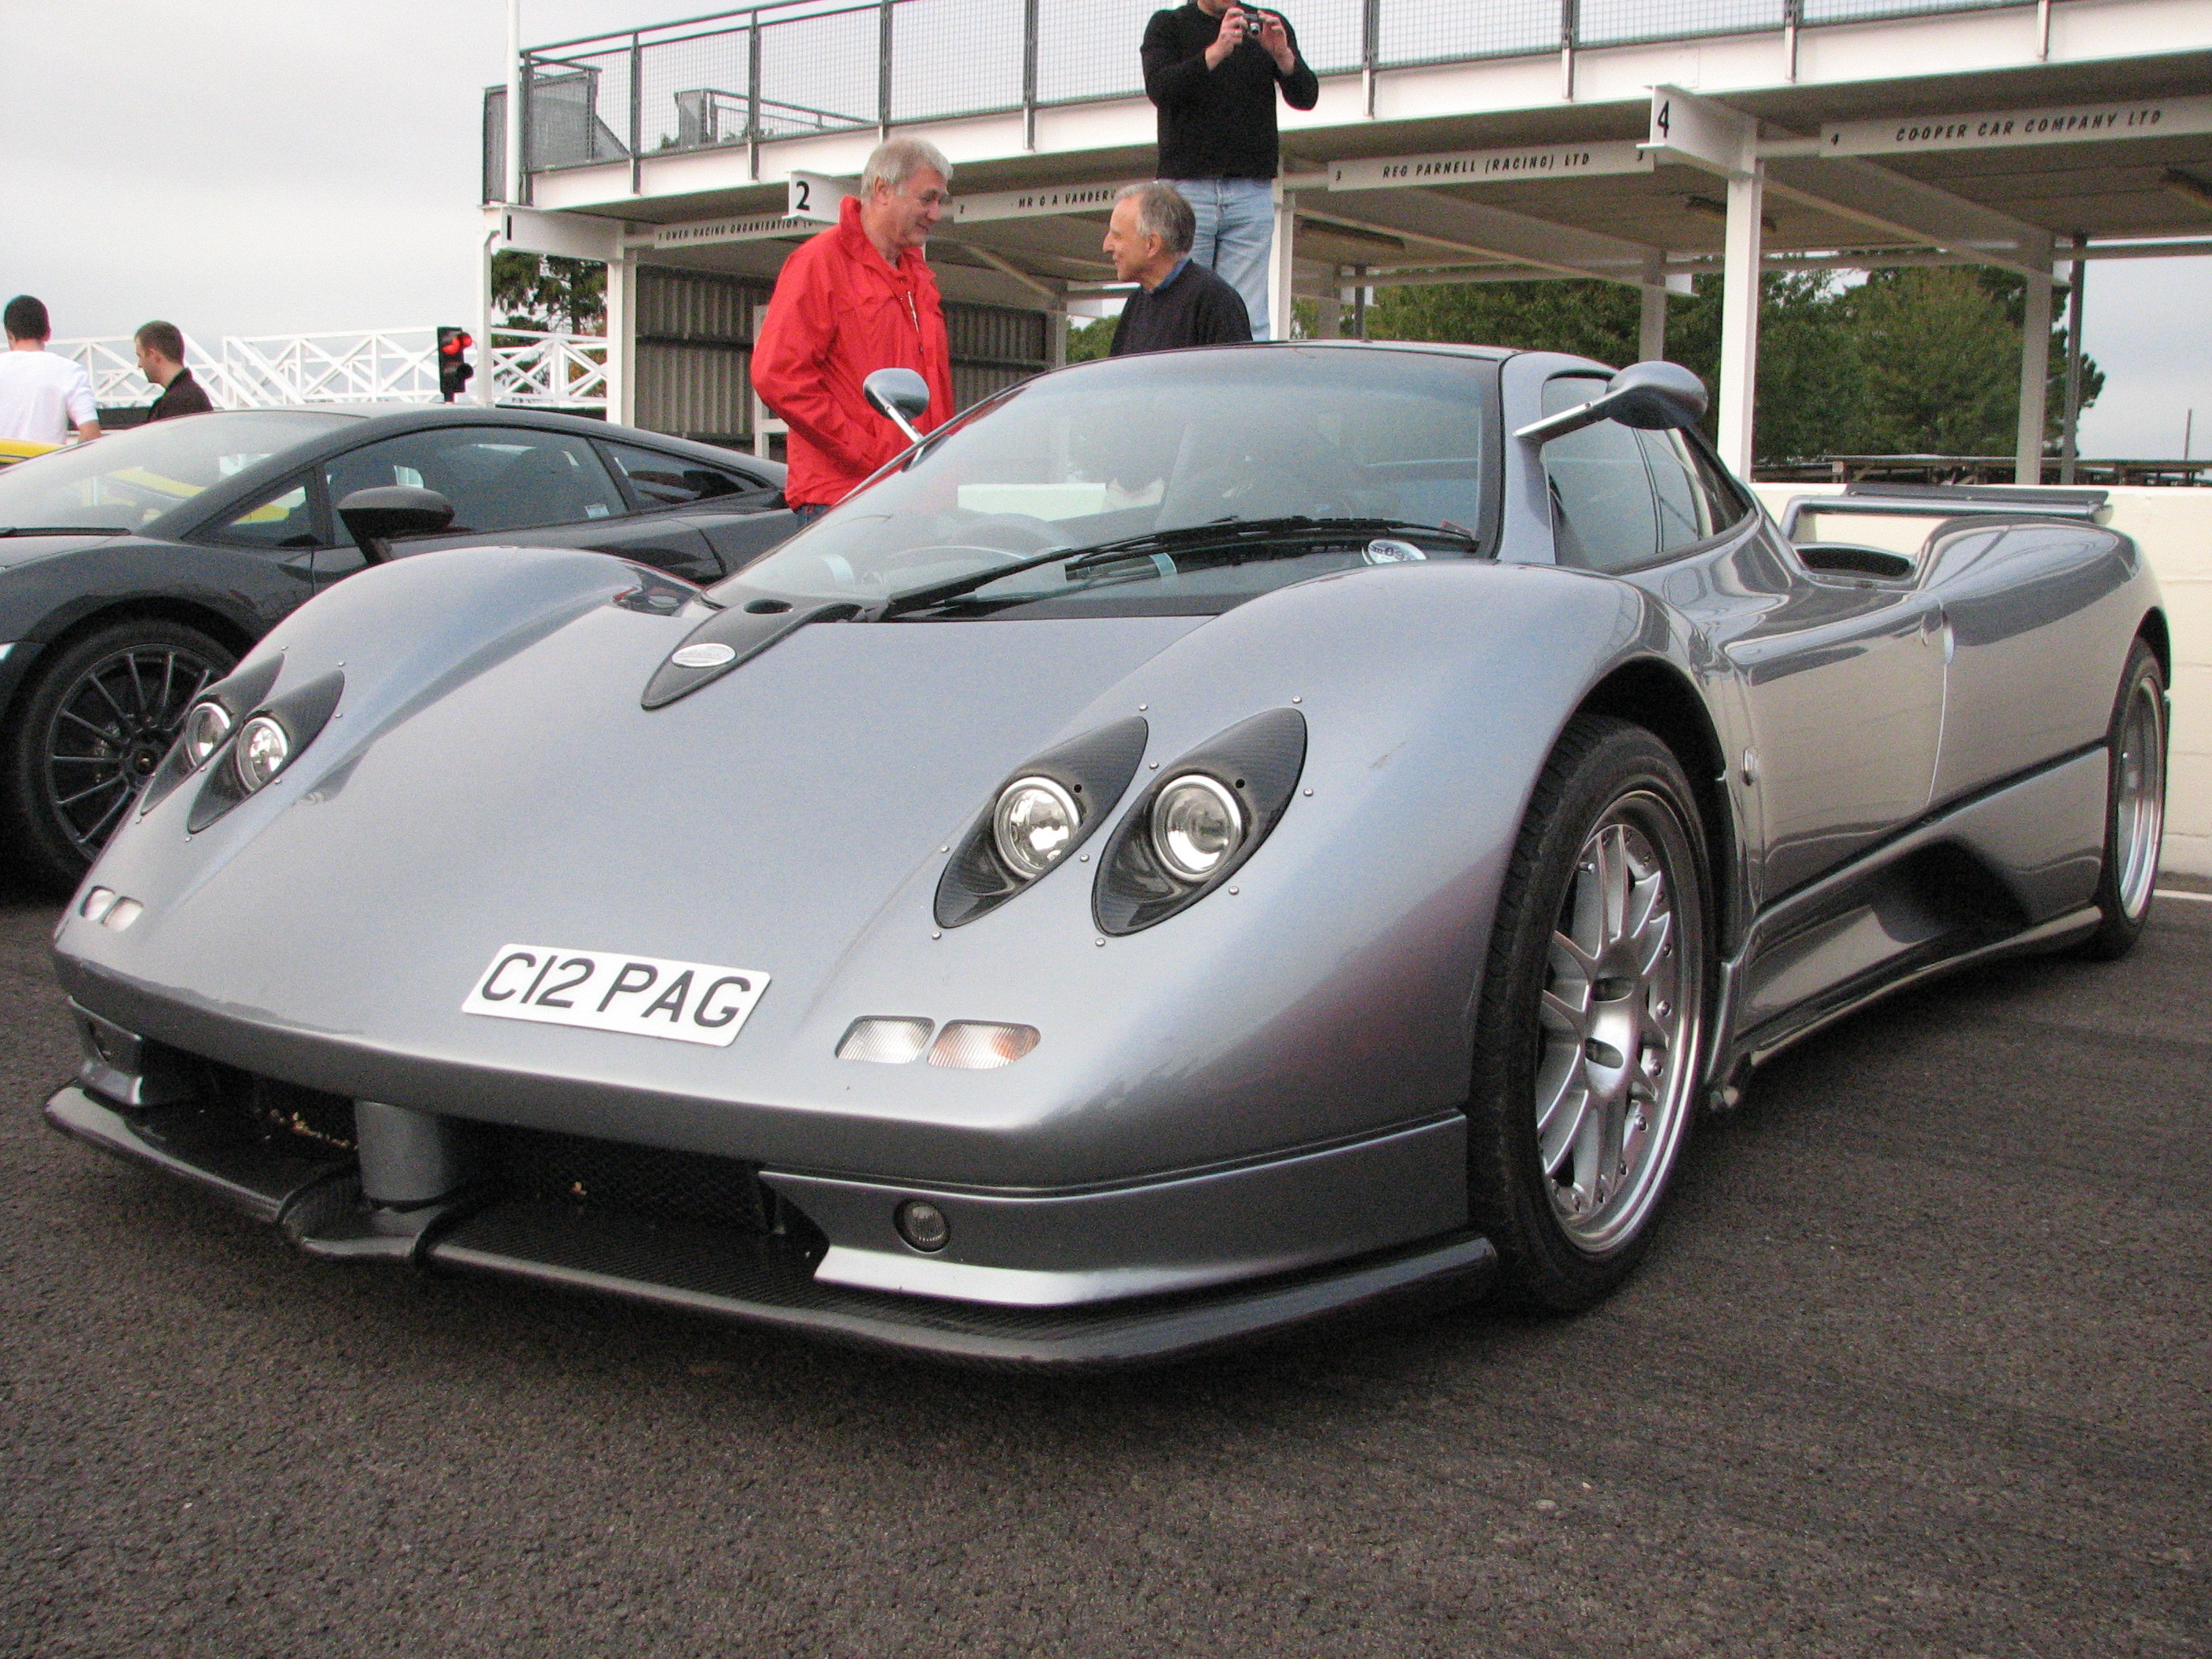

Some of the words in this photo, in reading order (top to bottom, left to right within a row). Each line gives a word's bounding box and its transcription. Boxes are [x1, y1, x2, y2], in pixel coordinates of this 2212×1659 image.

[1657, 99, 1669, 139] 4
[1830, 132, 1840, 146] 4
[1895, 123, 1968, 142] COOPER
[1977, 120, 2015, 137] CAR
[2024, 112, 2118, 133] COMPANY
[2127, 109, 2161, 126] LTD
[1382, 164, 1408, 179] REG
[1415, 160, 1476, 177] PARNELL
[1485, 154, 1555, 174] (RACING)
[1564, 152, 1591, 167] LTD
[796, 181, 810, 211] 2
[1018, 196, 1034, 209] MR
[1052, 194, 1058, 206] A
[1064, 189, 1117, 205] VANDERV
[730, 218, 798, 234] ORGANISATION
[482, 951, 595, 1009] C12
[596, 962, 752, 1028] PAG
